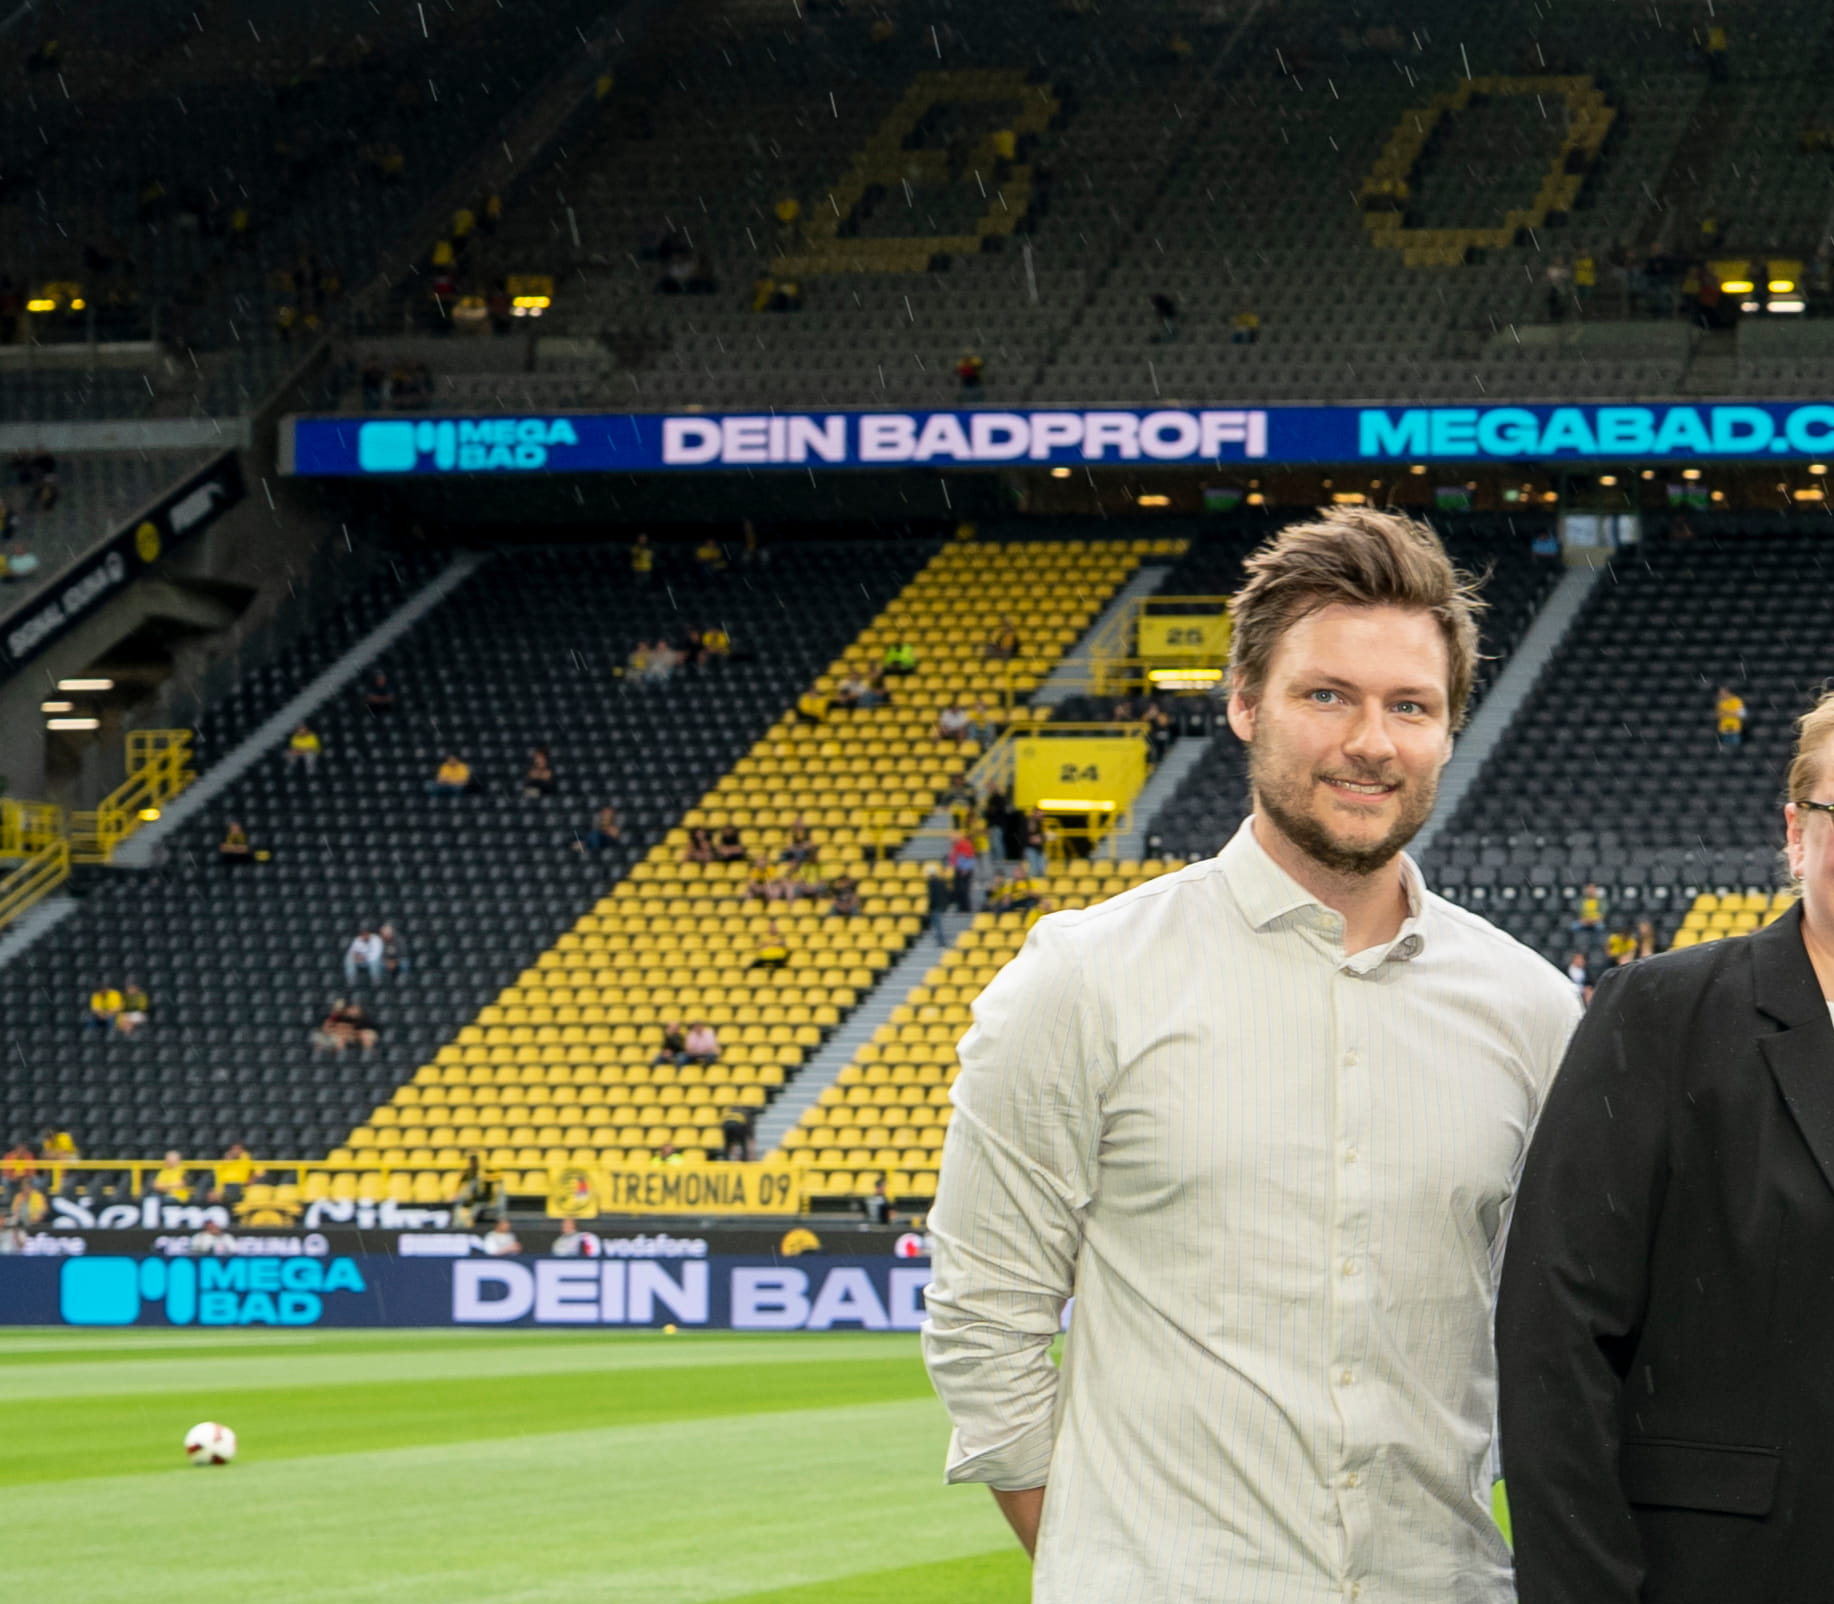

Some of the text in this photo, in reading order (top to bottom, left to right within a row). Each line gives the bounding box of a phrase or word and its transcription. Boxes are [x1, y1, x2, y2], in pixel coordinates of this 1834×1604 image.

[458, 418, 578, 445] MEGA
[662, 410, 1268, 464] DEIN BADPROFI
[458, 445, 545, 470] BAD
[1060, 764, 1098, 781] 24
[611, 1173, 791, 1206] TREMONIA 09
[602, 1233, 708, 1258] vodafone
[200, 1257, 366, 1293] MEGA
[453, 1260, 709, 1323] DEIN
[200, 1291, 323, 1326] BAD
